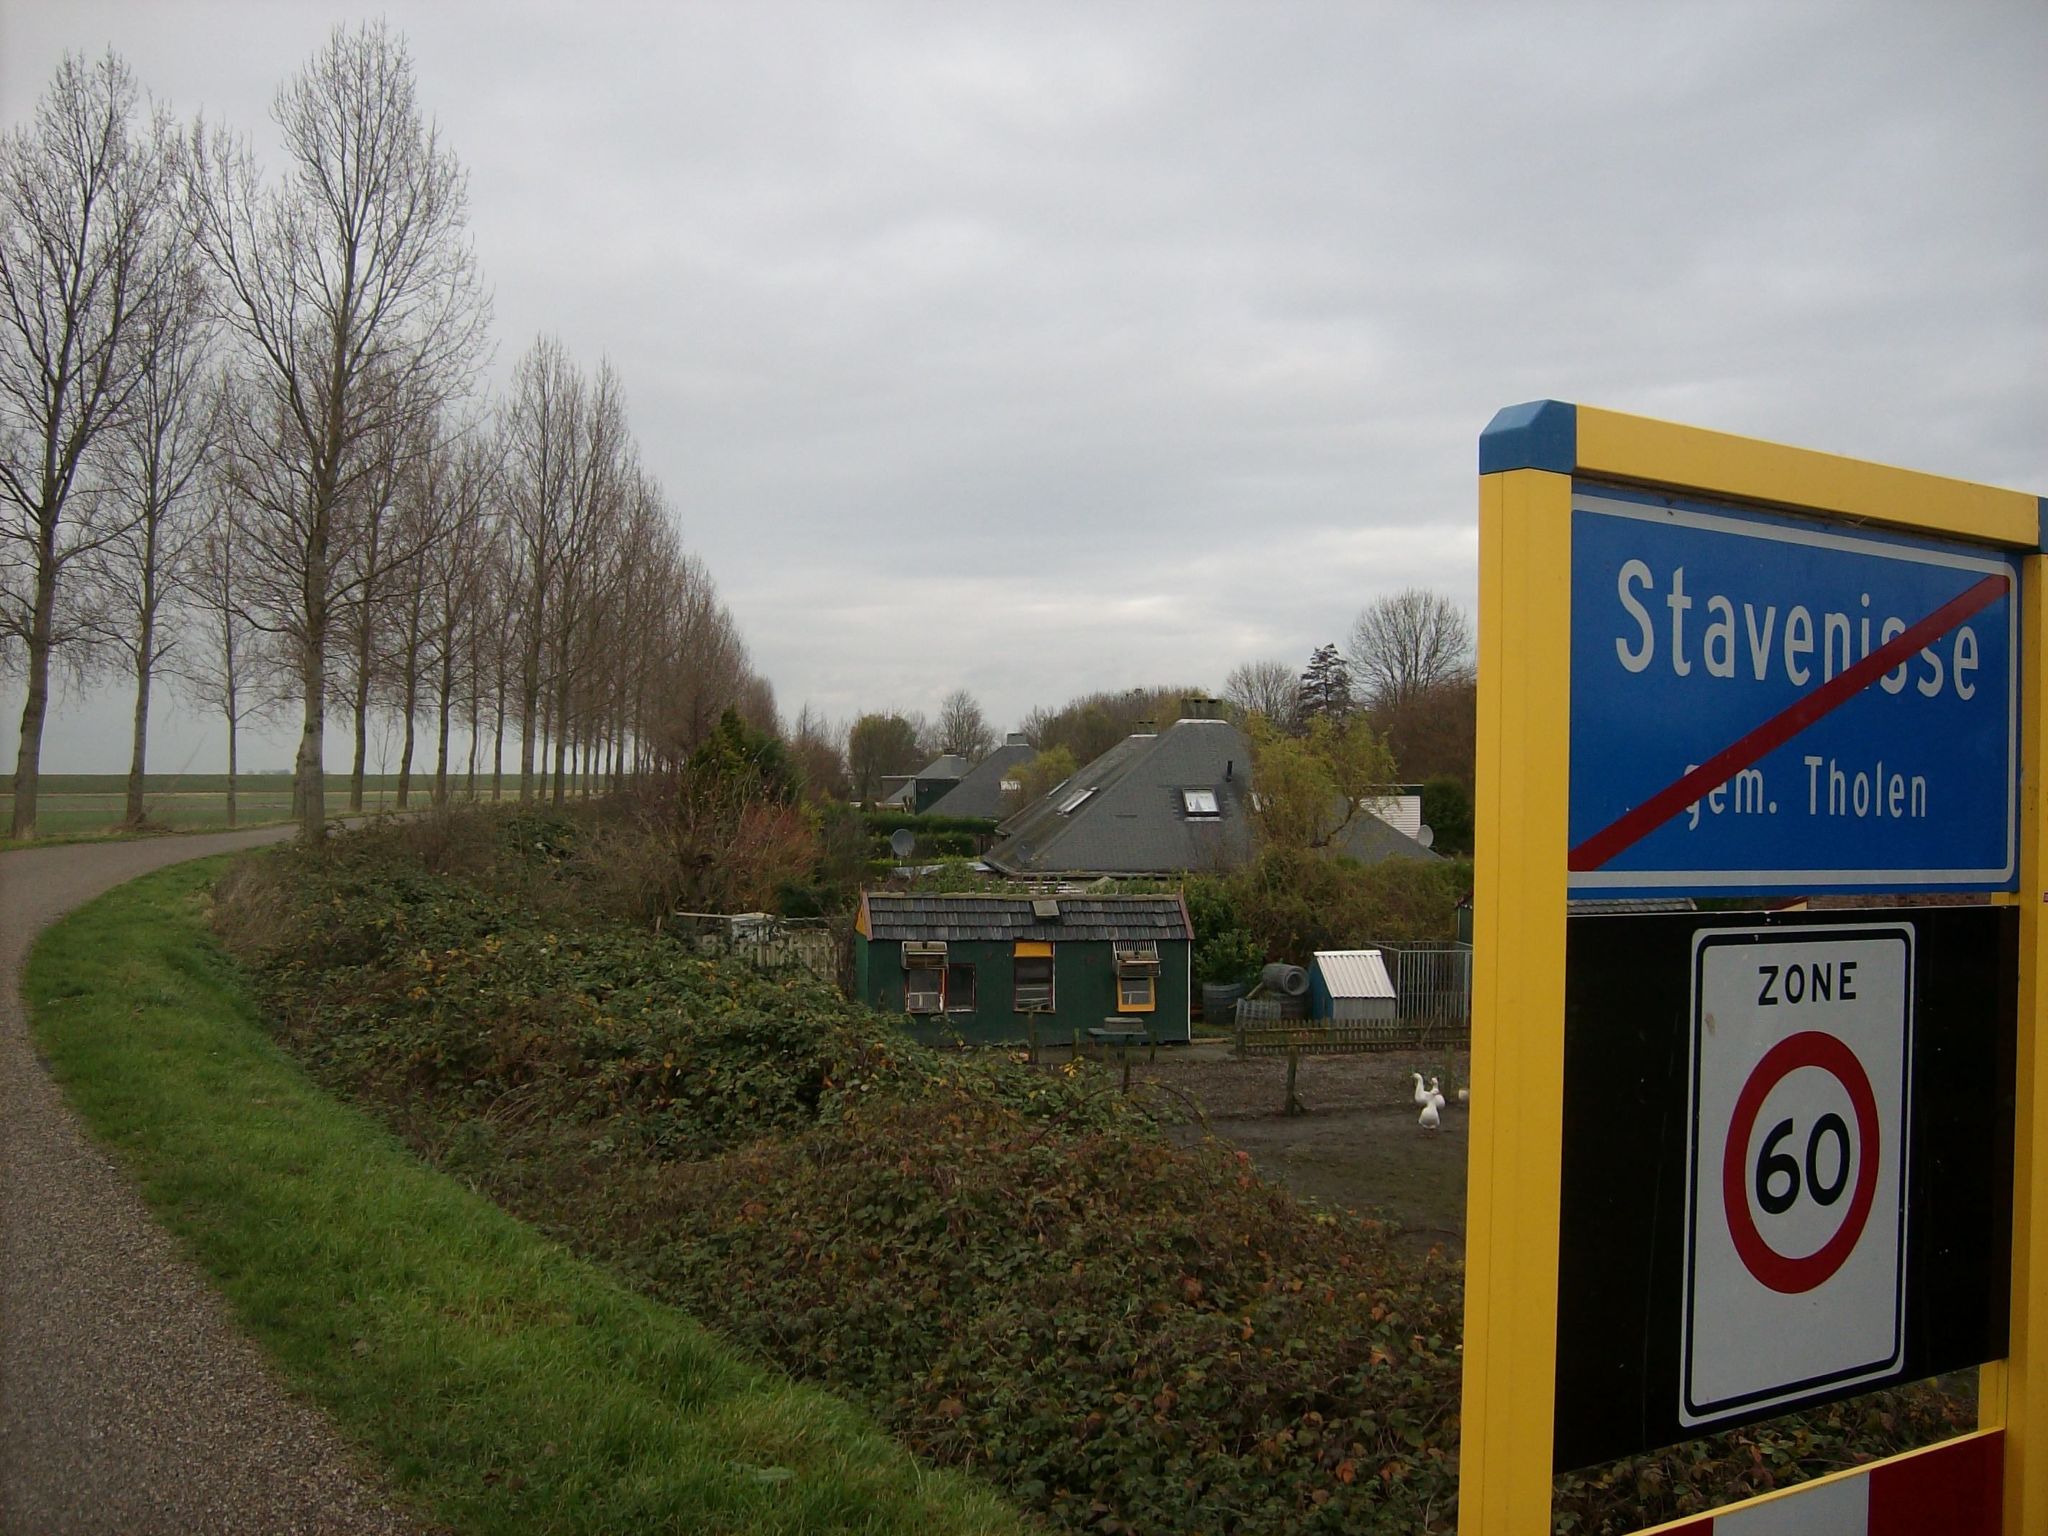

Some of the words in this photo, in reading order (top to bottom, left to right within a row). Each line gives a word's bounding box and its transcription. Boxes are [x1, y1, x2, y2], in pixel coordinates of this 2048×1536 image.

[1615, 558, 1979, 701] Stavenisse
[1804, 756, 1926, 818] Tholen
[1757, 961, 1857, 1005] ZONE
[1755, 1112, 1850, 1214] 60
